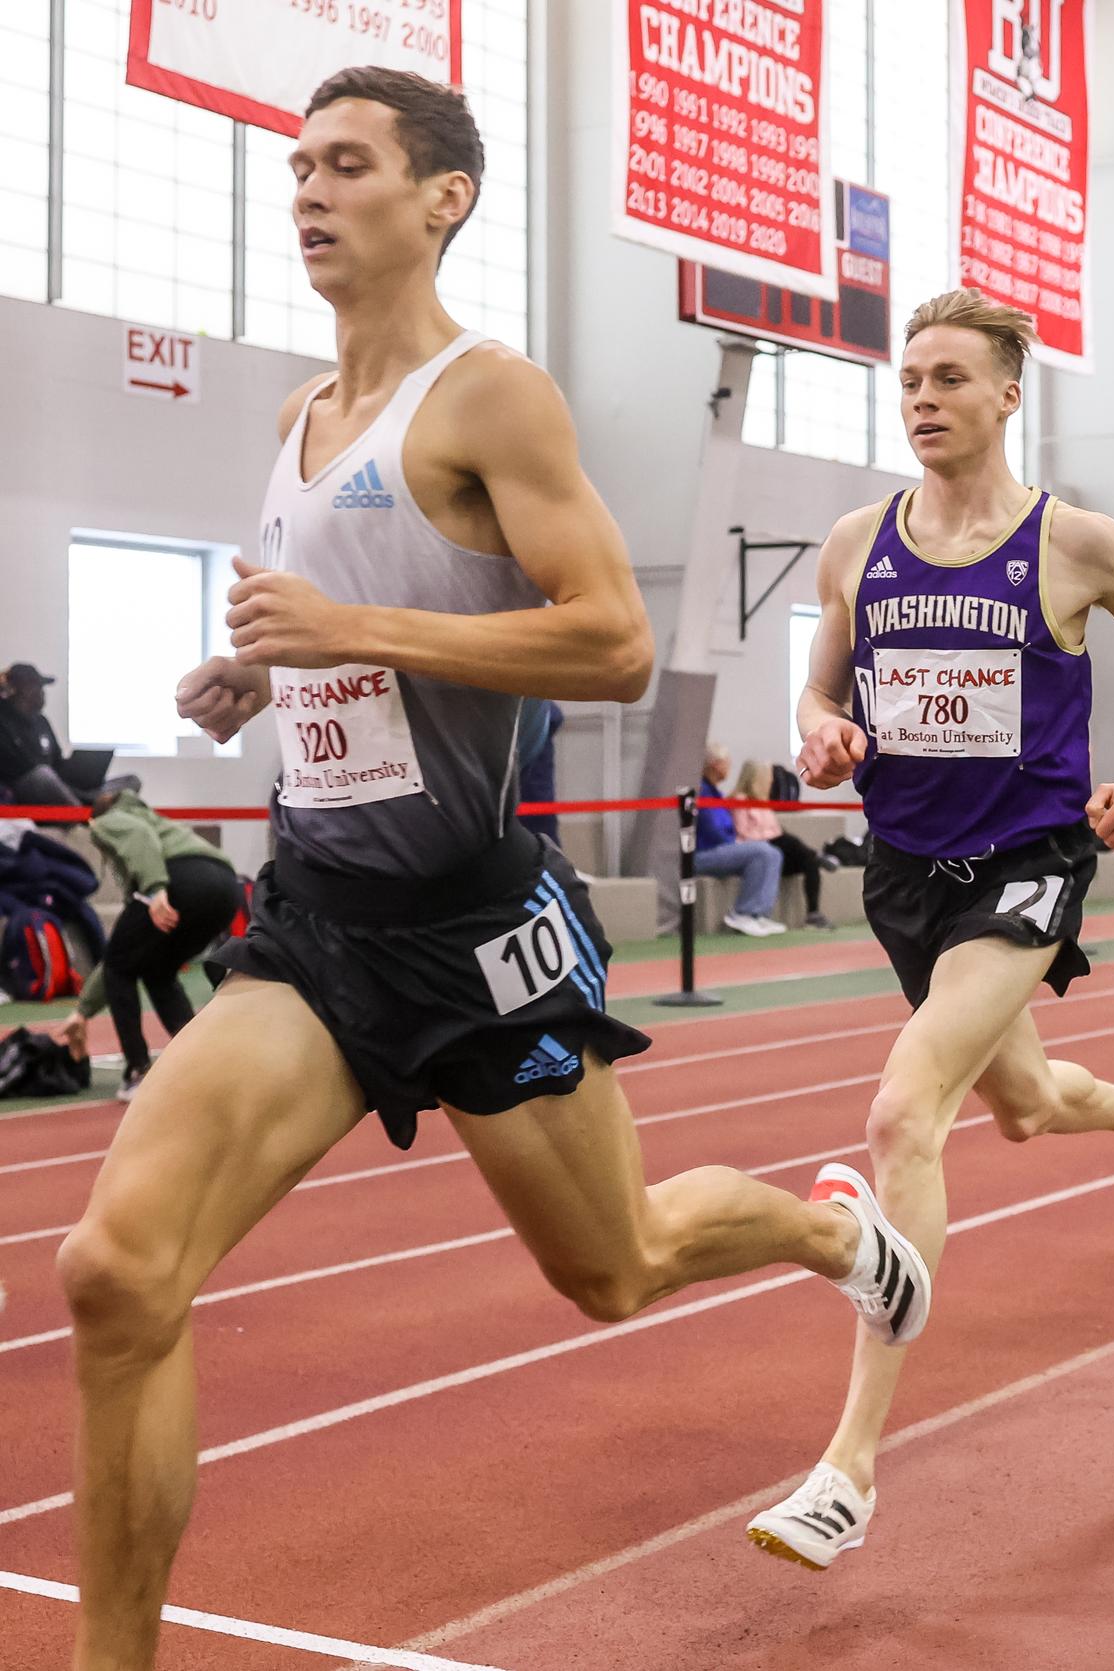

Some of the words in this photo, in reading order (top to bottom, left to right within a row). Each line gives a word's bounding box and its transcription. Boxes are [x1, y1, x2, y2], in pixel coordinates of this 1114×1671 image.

[347, 4, 391, 42] 1997
[640, 4, 815, 125] CHAMPIONS
[673, 87, 709, 124] 1991
[712, 103, 748, 138] 1992
[751, 118, 788, 154] 1993
[789, 133, 819, 163] 199
[673, 124, 709, 158] 1997
[786, 166, 819, 200] 200
[670, 159, 709, 196] 2002
[711, 174, 749, 209] 2004
[750, 187, 785, 222] 2005
[627, 181, 668, 219] 2013
[670, 196, 710, 233] 2014
[710, 210, 748, 245] 2019
[749, 222, 787, 256] 2020
[127, 328, 194, 370] EXIT
[331, 487, 395, 510] adidas
[866, 569, 898, 579] adidas
[865, 595, 1028, 643] WASHINGTON
[300, 670, 391, 709] CHANCE
[879, 668, 930, 687] LAST
[937, 668, 1016, 688] CHANCE
[918, 694, 969, 725] 780
[881, 731, 893, 741] at
[898, 728, 938, 743] Boston
[943, 729, 1014, 745] University
[501, 916, 563, 997] 10
